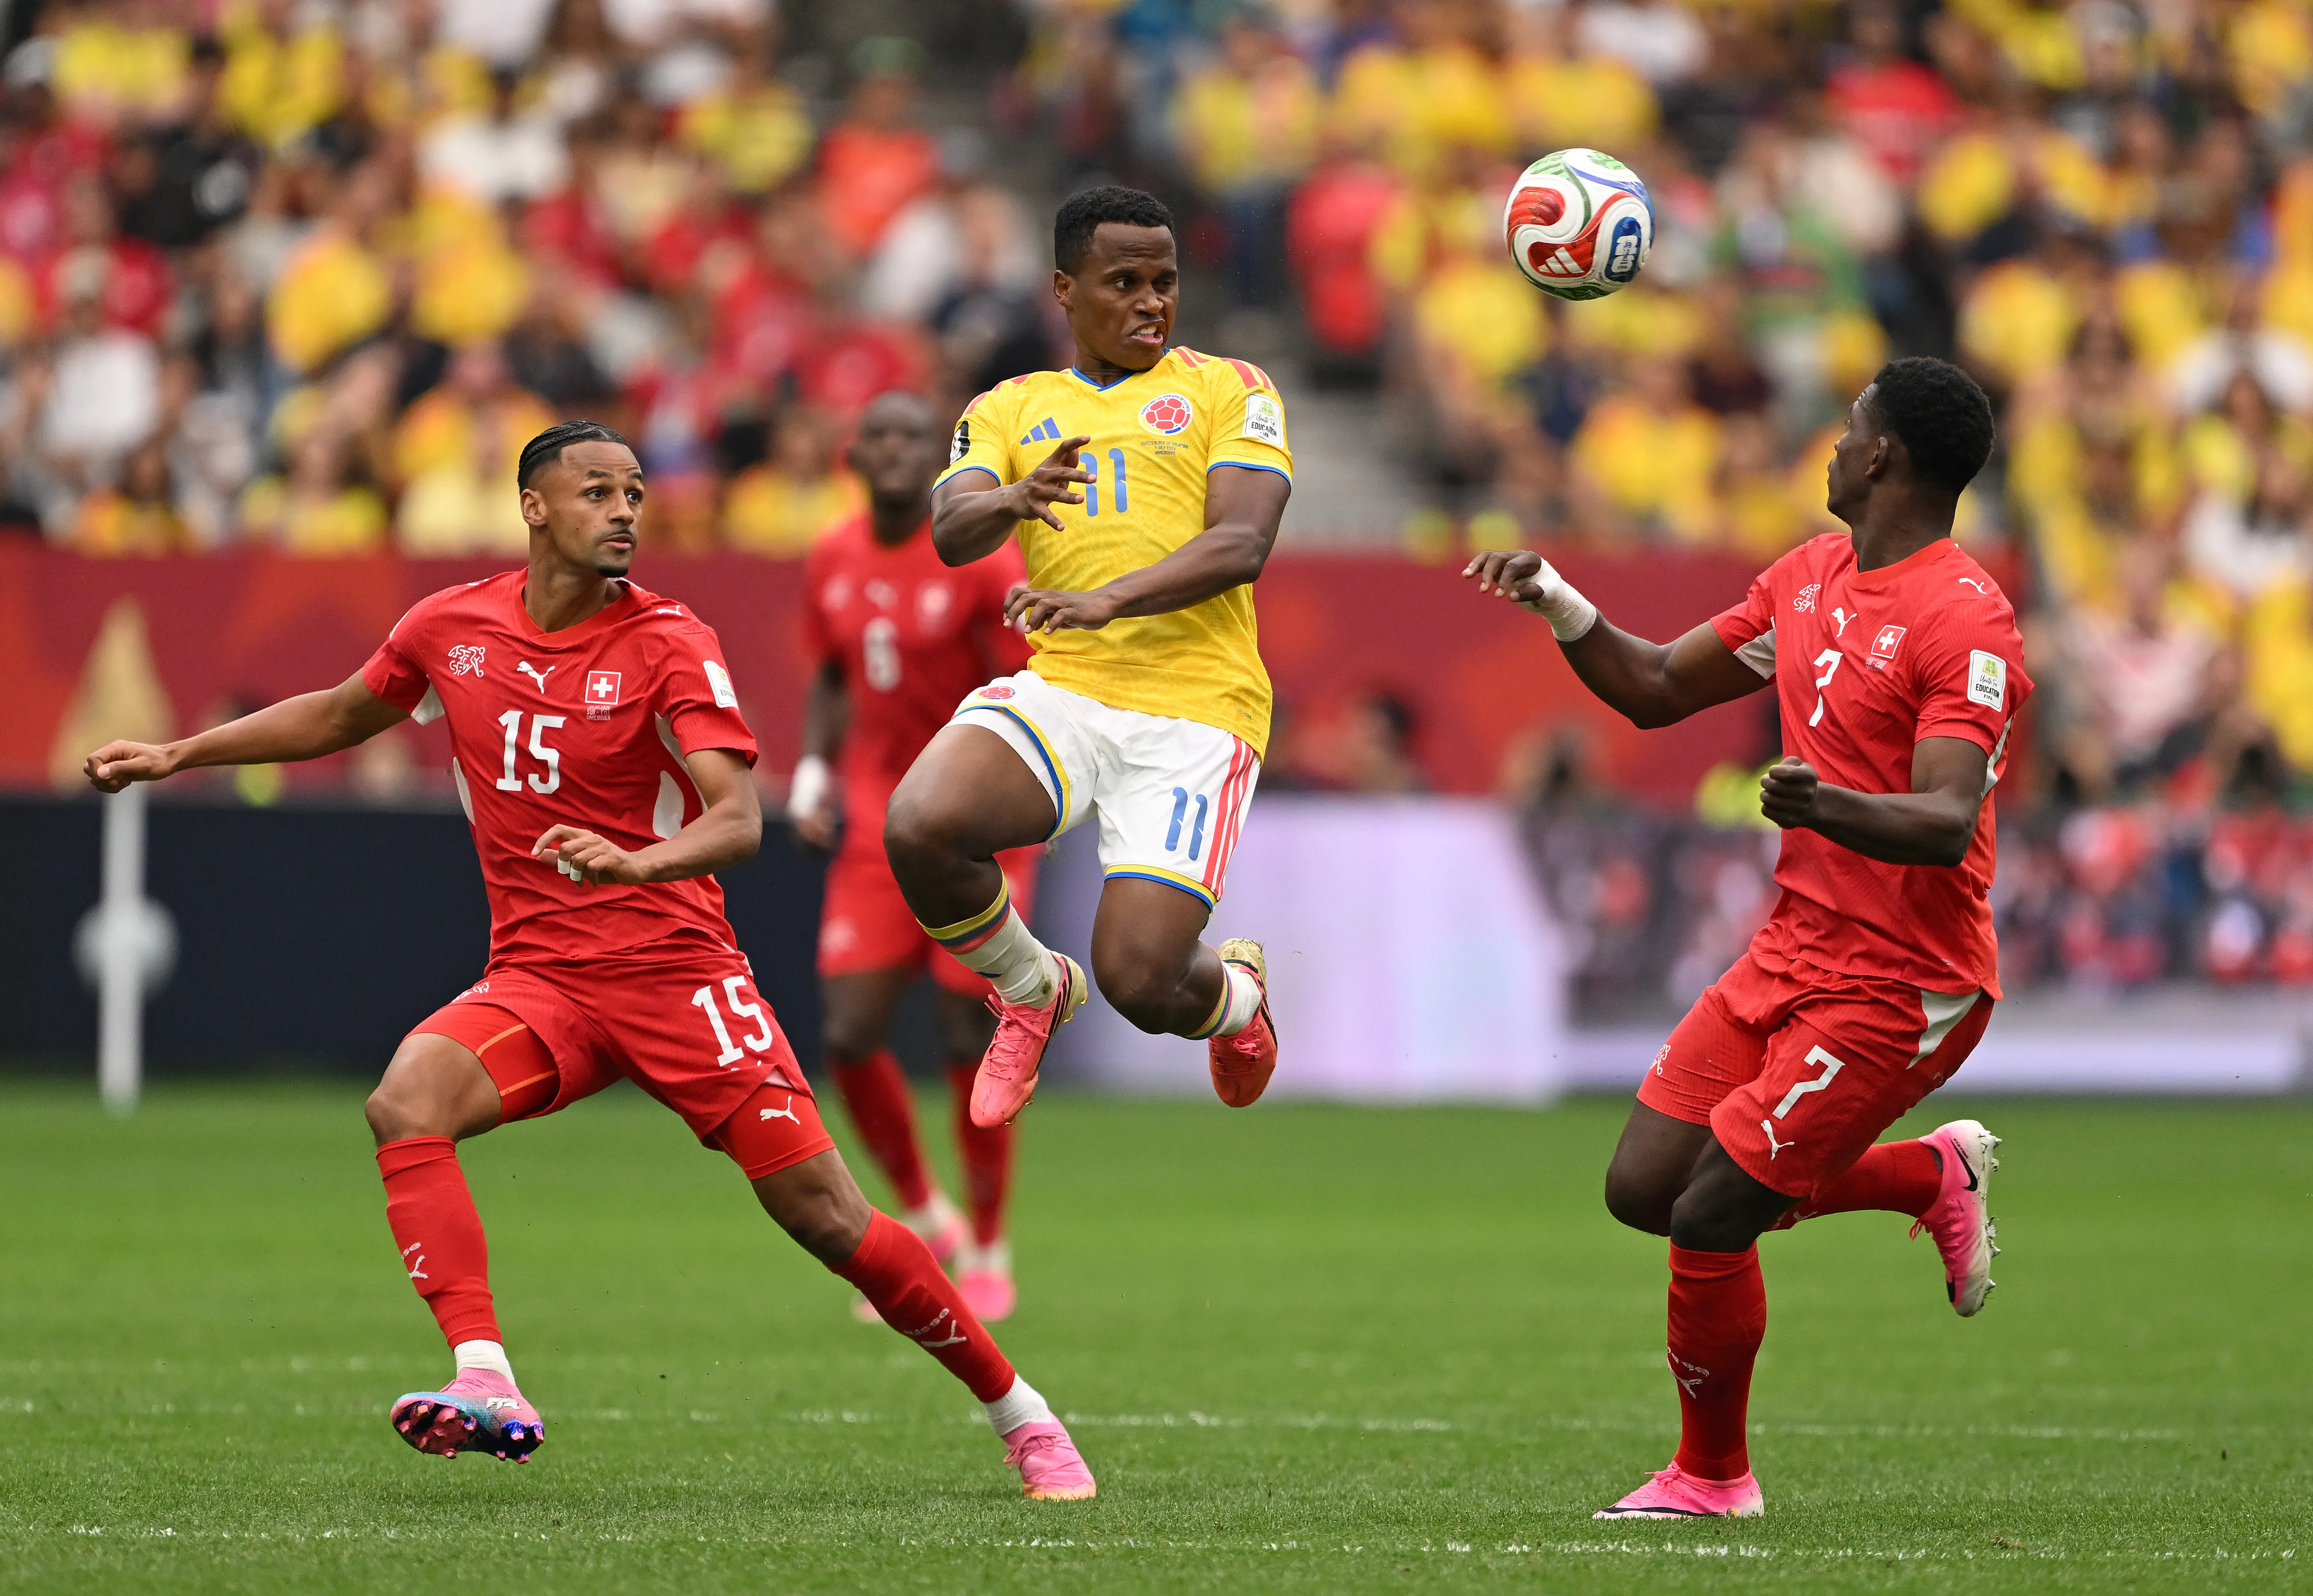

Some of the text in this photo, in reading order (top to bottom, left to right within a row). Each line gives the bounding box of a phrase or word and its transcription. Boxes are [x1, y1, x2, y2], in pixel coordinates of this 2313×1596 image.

[1251, 422, 1277, 437] EDUCATION
[1079, 448, 1128, 517] 11
[1808, 648, 1844, 727] 7
[1976, 683, 1999, 699] EDUCATION
[496, 711, 565, 794] 15
[1165, 786, 1208, 861] 11
[691, 975, 772, 1067] 15
[1772, 1045, 1845, 1120] 7
